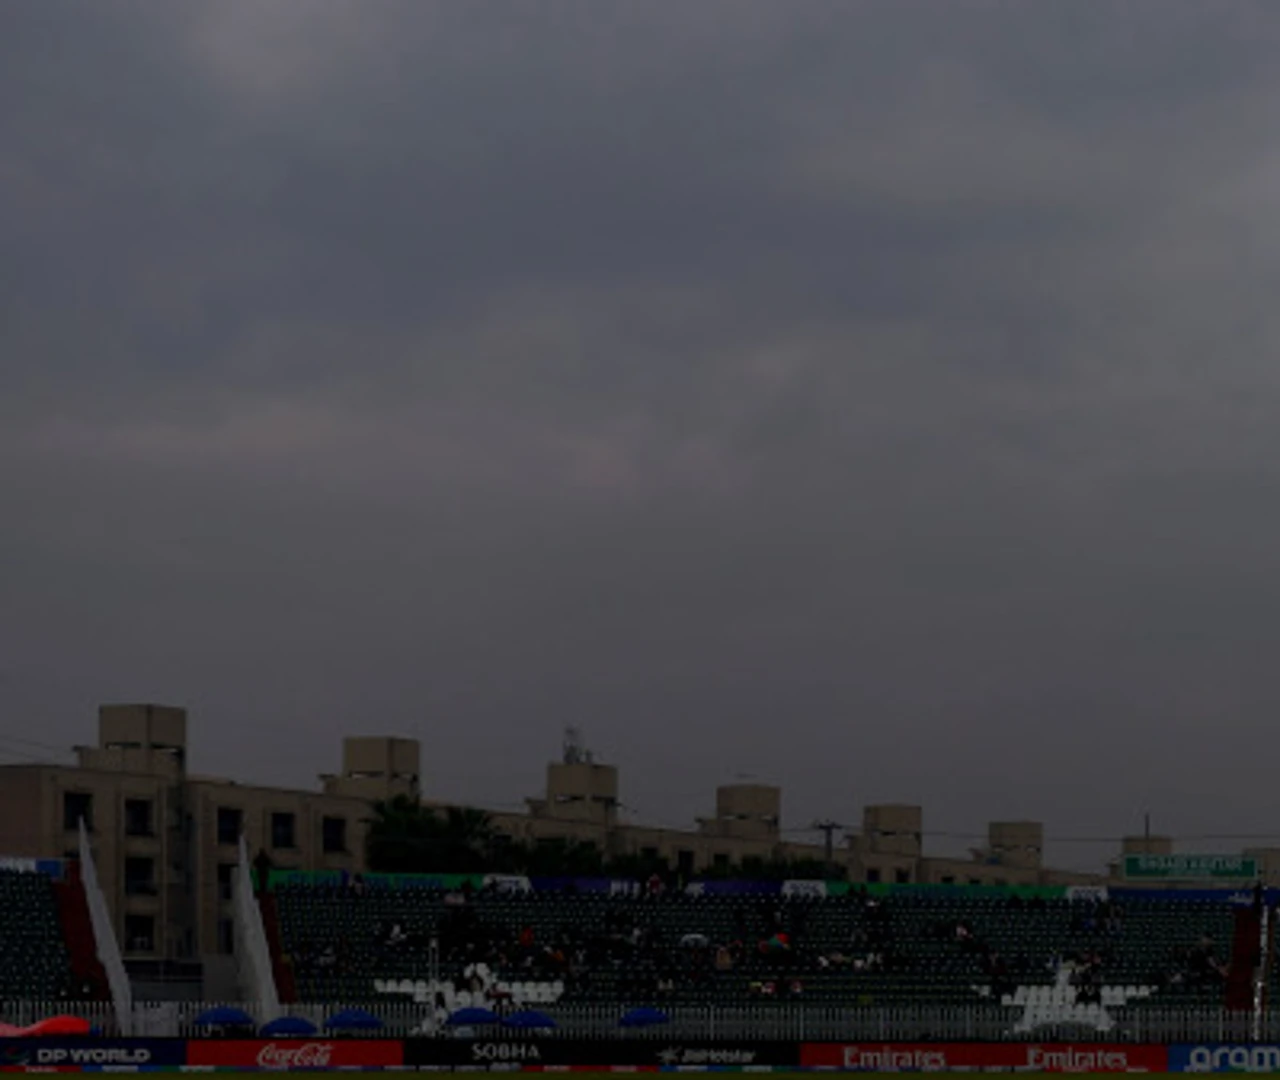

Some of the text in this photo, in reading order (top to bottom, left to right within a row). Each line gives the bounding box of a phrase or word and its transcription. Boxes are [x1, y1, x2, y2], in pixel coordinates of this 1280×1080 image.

[37, 1048, 151, 1063] DP WORLD
[471, 1043, 541, 1060] SOBHA
[843, 1046, 946, 1067] Emirates
[1027, 1046, 1127, 1068] Emirates
